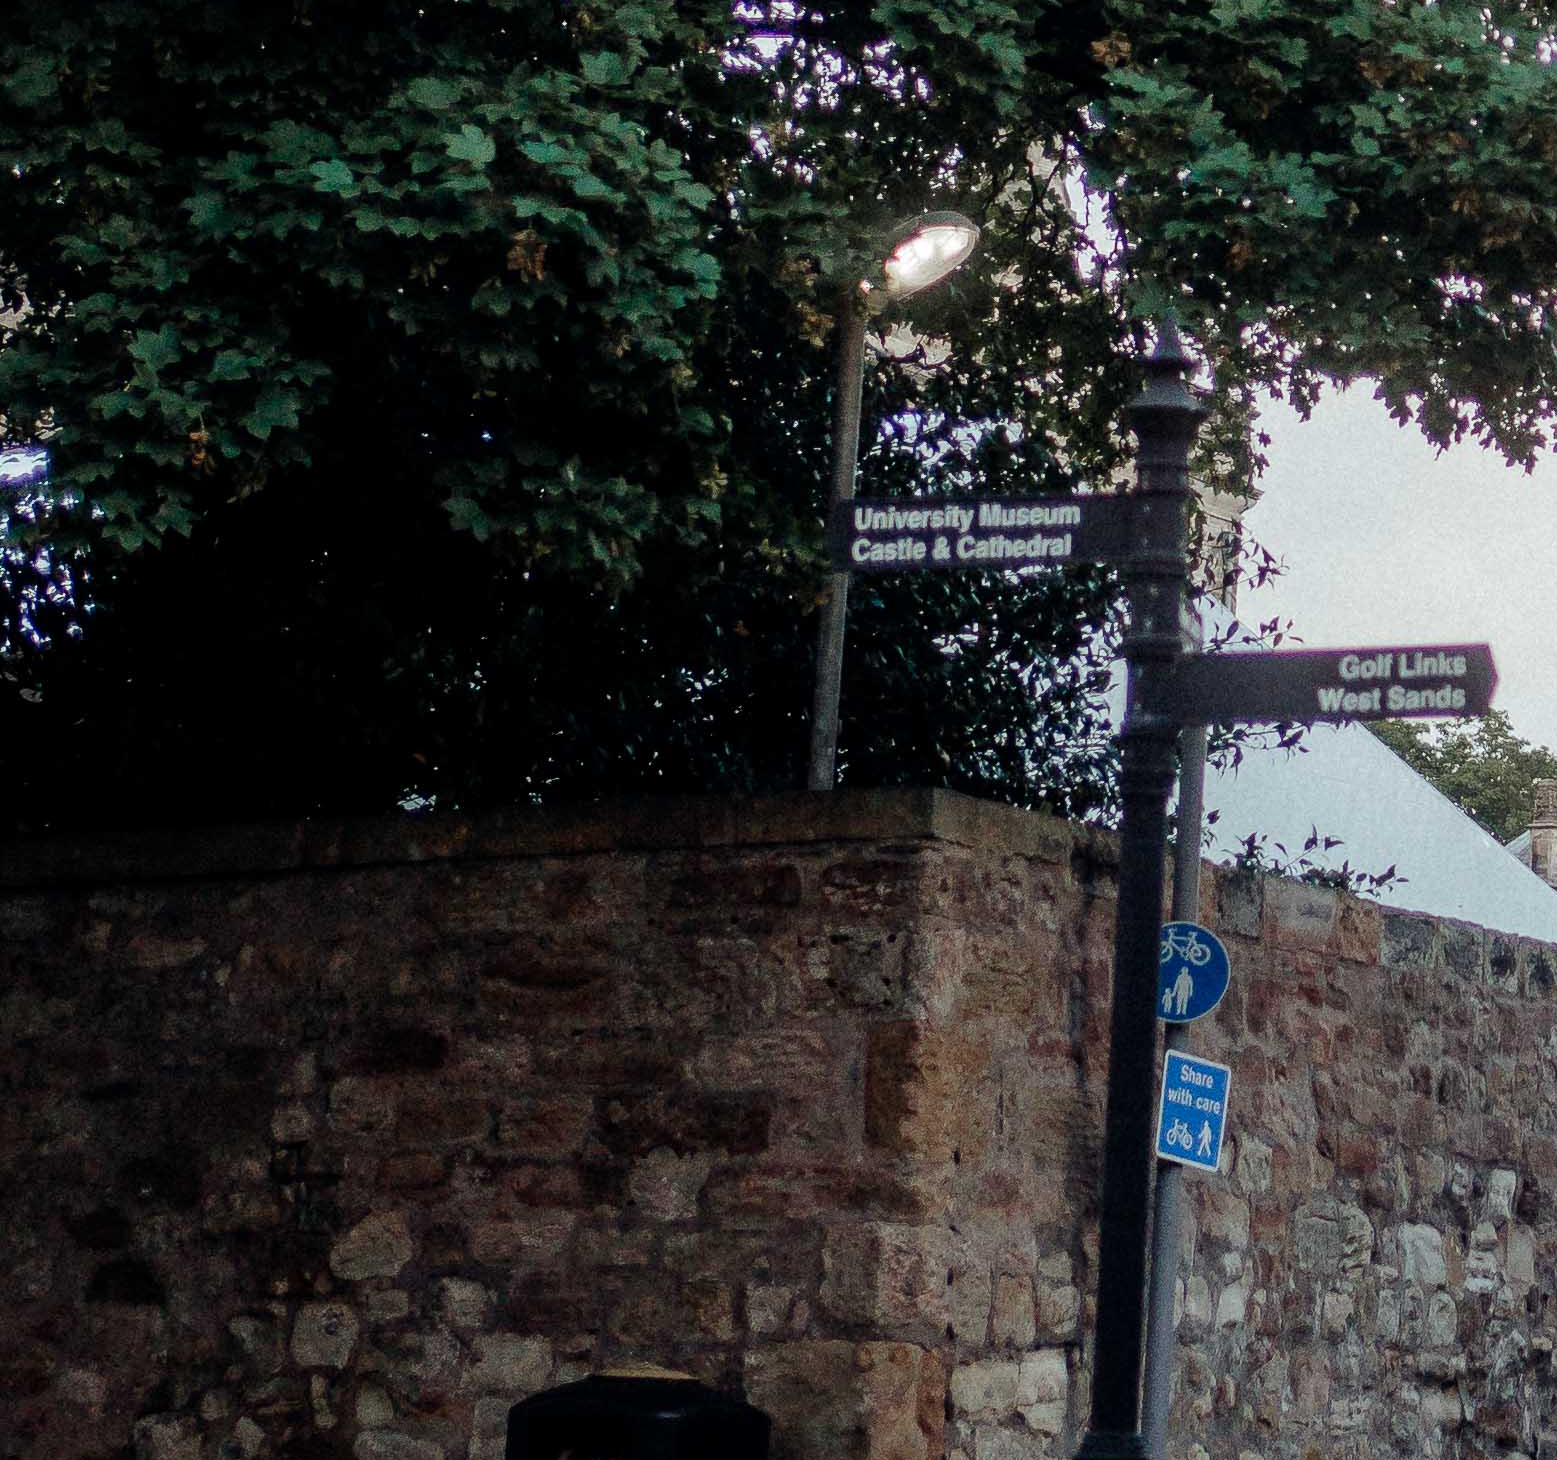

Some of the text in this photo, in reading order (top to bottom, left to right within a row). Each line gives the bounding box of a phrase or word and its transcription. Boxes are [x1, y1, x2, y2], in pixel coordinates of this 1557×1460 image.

[854, 503, 1080, 533] University Museum
[851, 533, 1072, 561] Castle & Cathedral
[1339, 651, 1466, 680] Golf Links
[1318, 684, 1465, 712] West Sands
[1181, 1064, 1213, 1089] Share
[1168, 1087, 1220, 1114] with care
